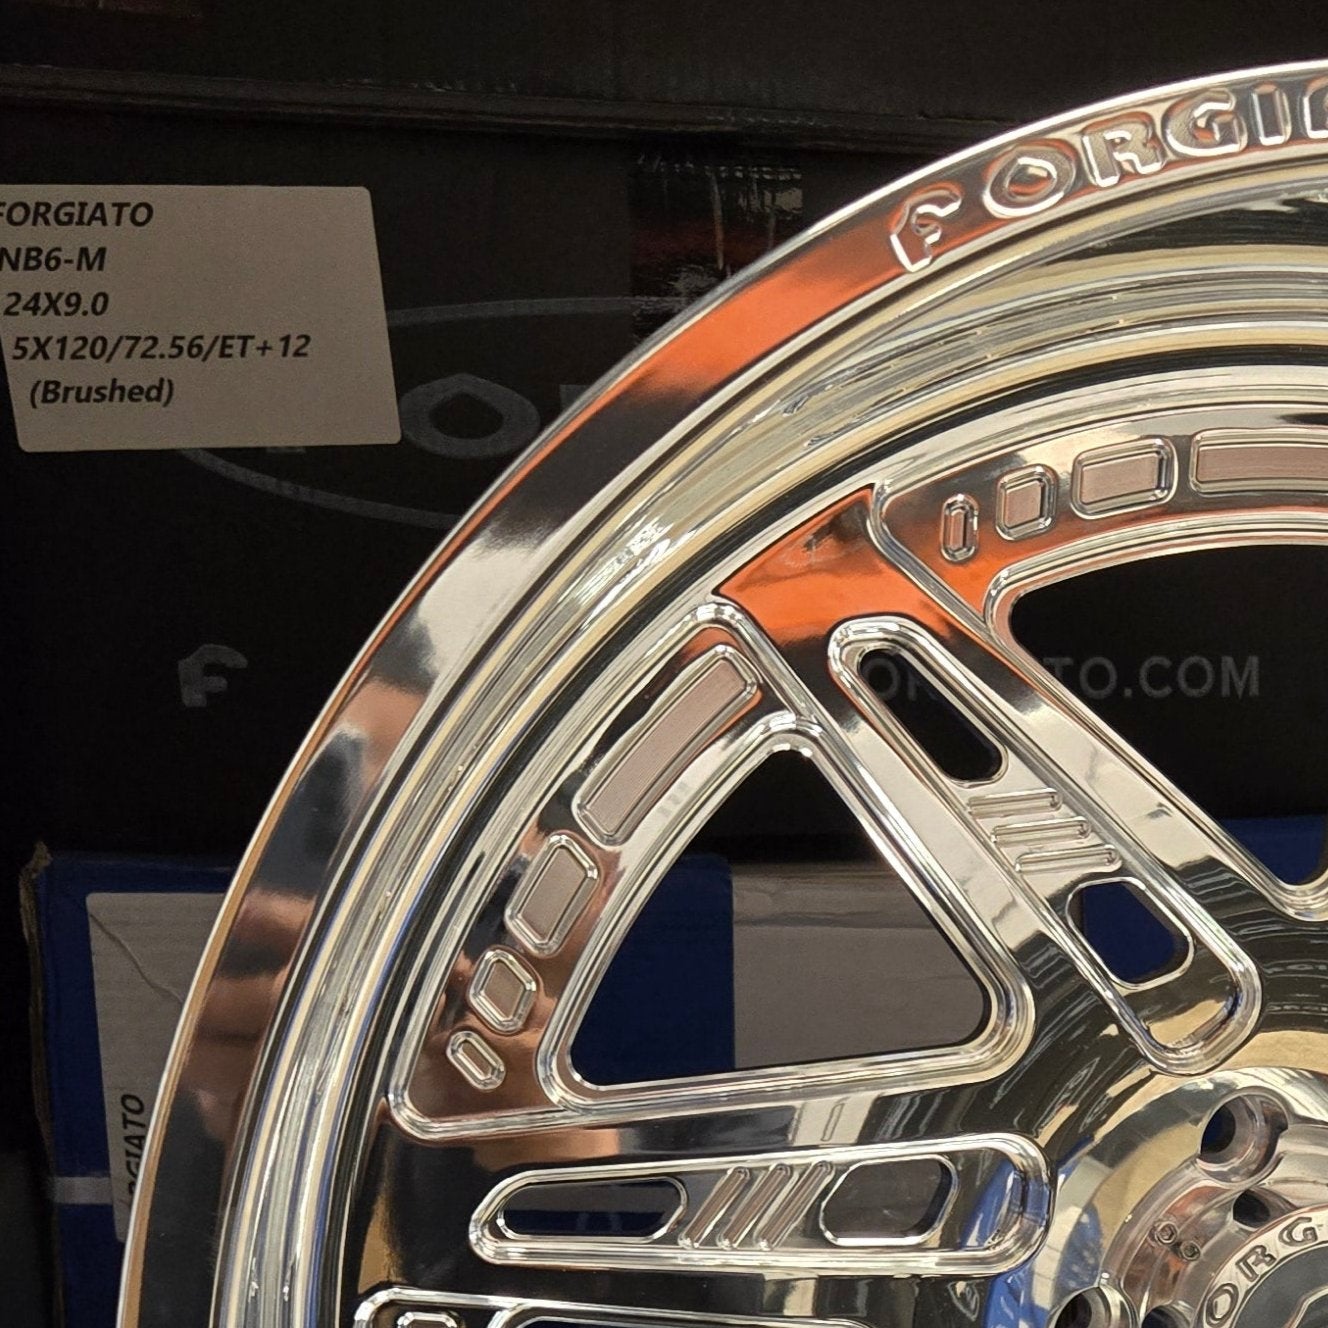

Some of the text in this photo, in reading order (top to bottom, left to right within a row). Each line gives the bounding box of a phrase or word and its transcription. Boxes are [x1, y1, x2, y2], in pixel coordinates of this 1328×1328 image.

[0, 246, 107, 272] NB6-M
[3, 292, 109, 317] 24X9.0
[12, 334, 311, 363] 5X120/72.56/ET+12
[29, 377, 174, 409] (Brushed)
[121, 1094, 146, 1196] GIATO
